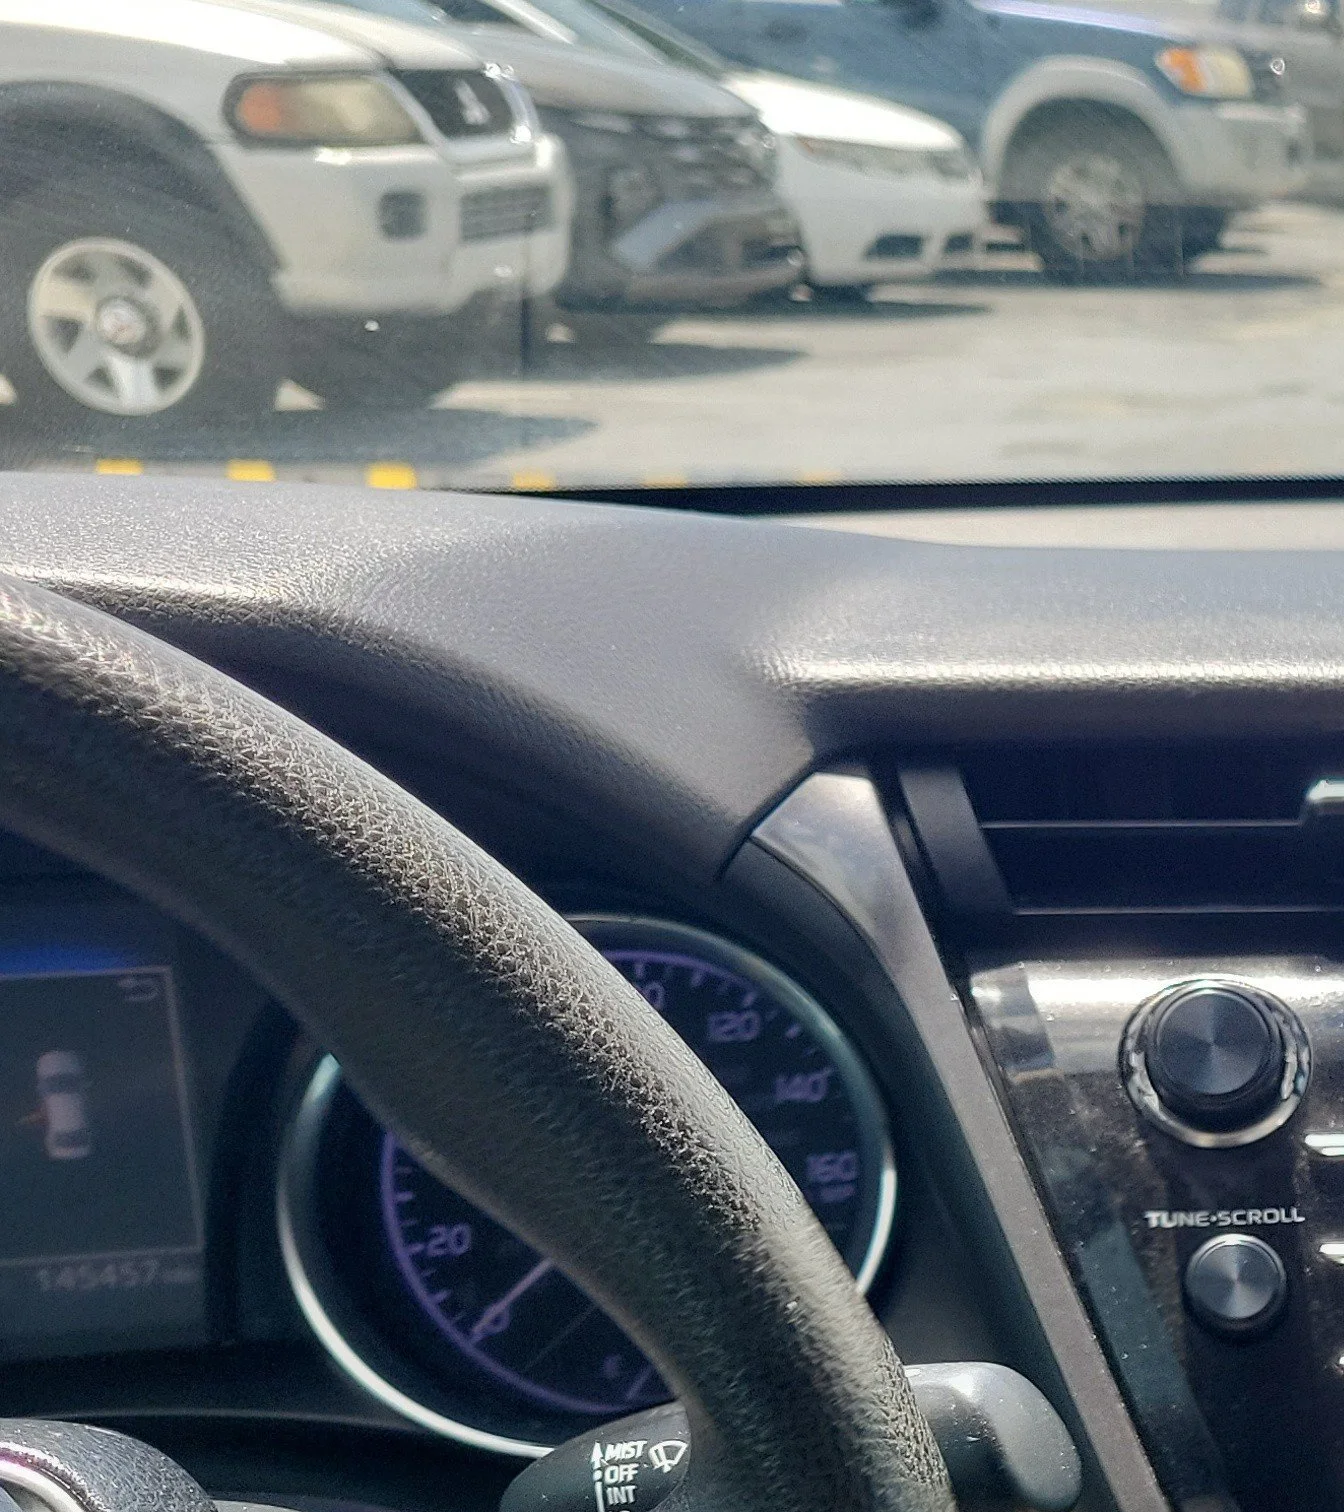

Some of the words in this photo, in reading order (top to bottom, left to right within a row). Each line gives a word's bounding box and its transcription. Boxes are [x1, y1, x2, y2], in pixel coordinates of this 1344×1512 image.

[427, 1222, 471, 1256] 20
[604, 1440, 648, 1461] MIST
[604, 1463, 640, 1485] OFF
[606, 1485, 637, 1506] INT
